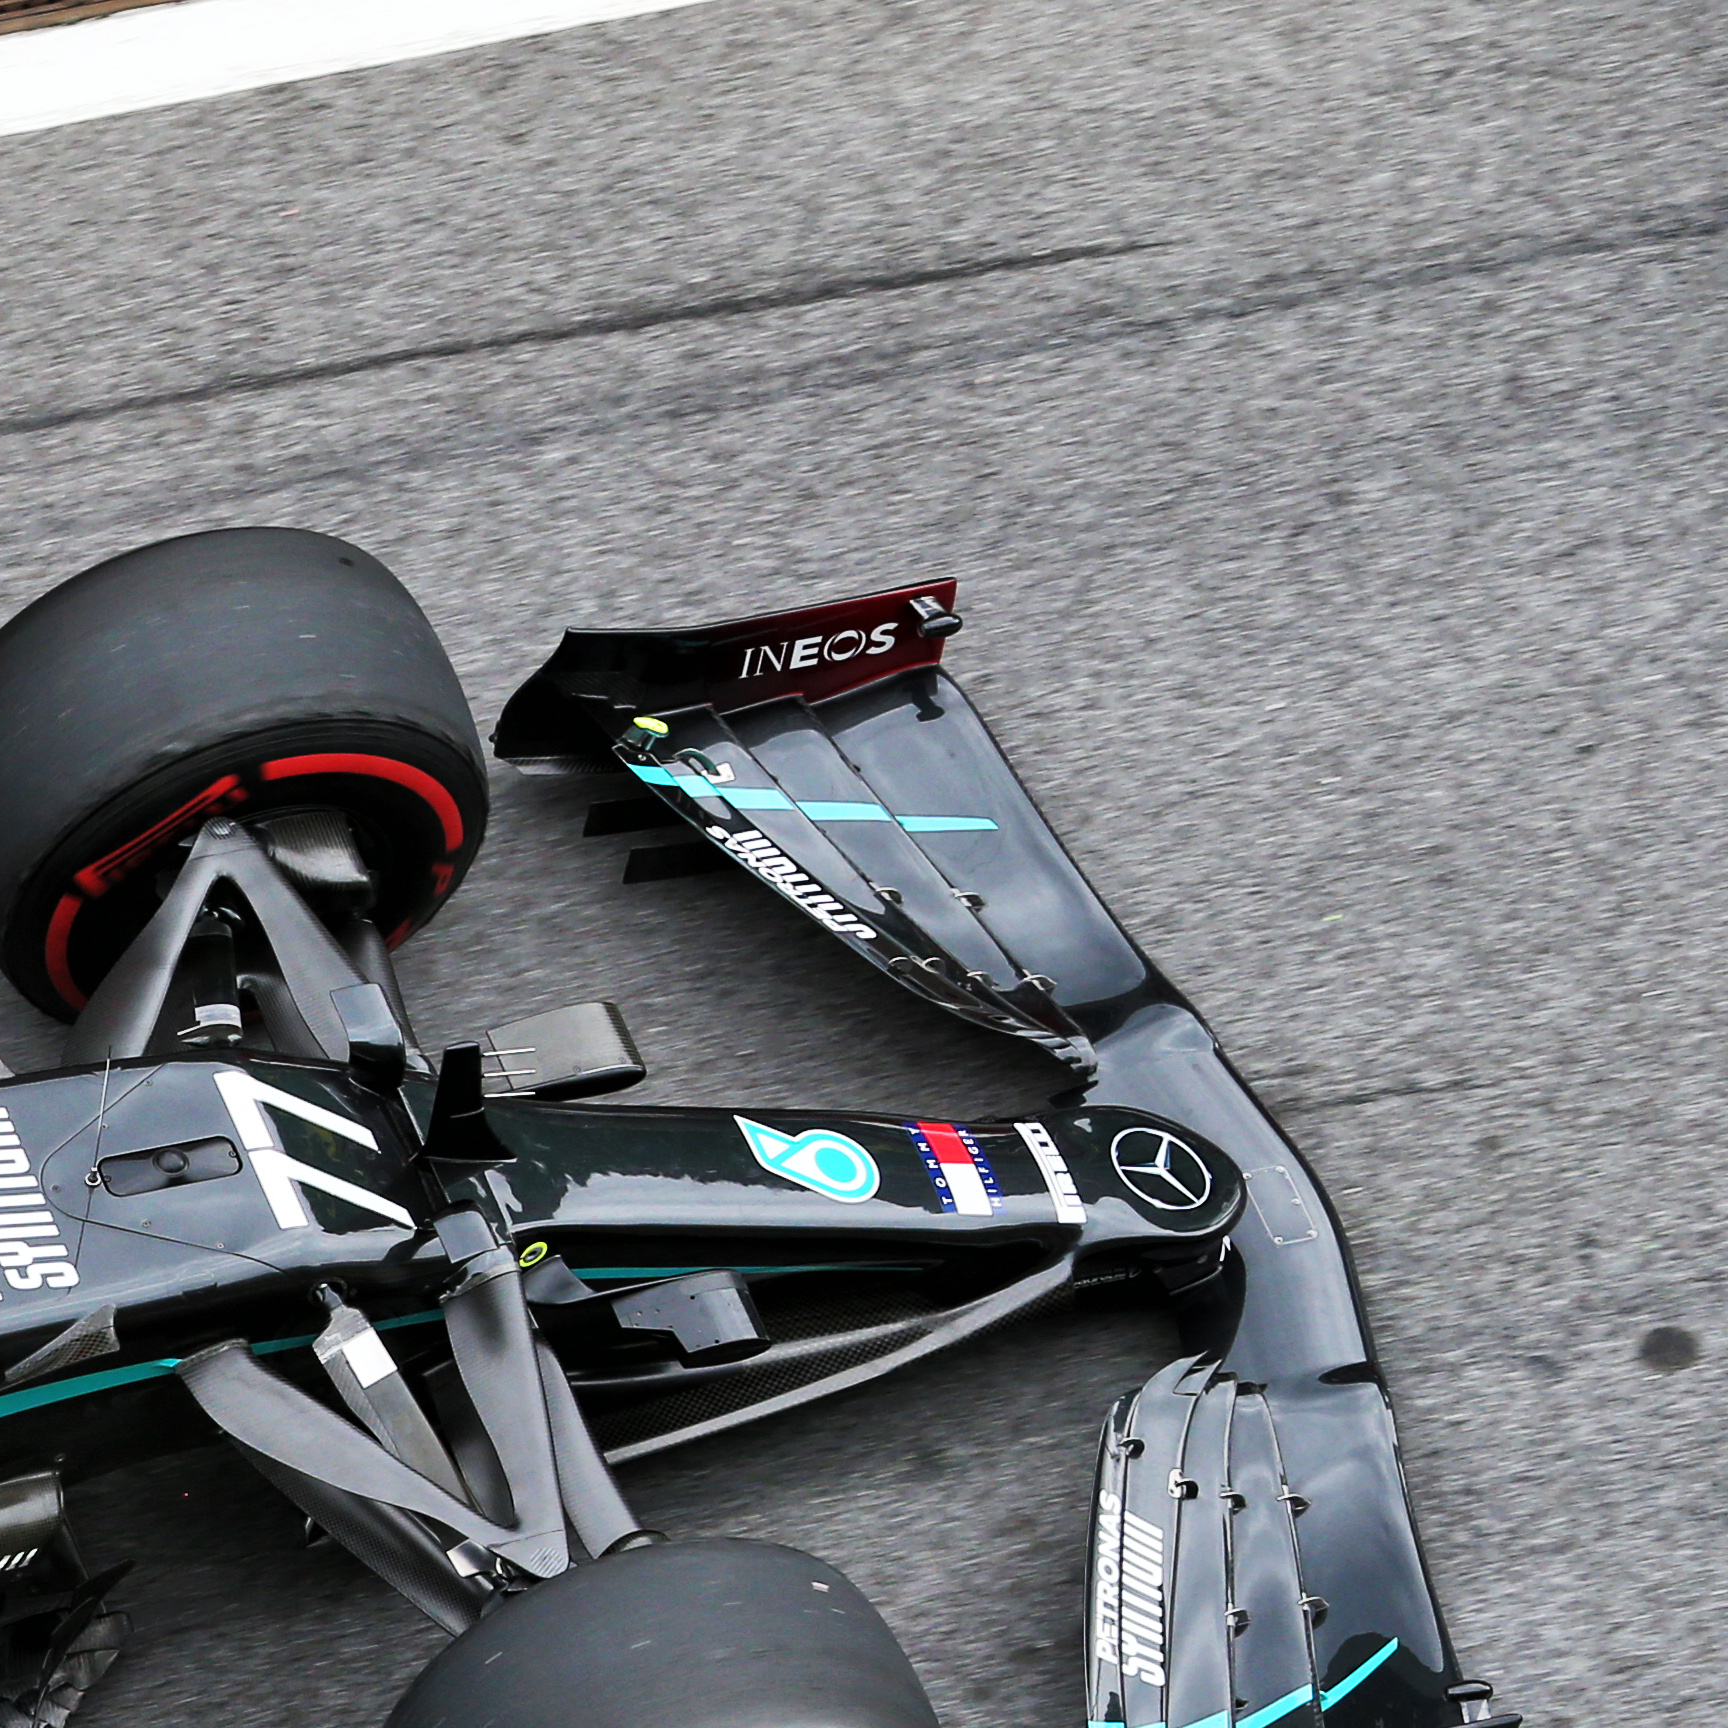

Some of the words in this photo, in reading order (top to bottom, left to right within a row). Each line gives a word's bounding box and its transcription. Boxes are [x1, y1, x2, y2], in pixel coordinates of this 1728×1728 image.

[738, 622, 897, 680] INEOS
[213, 1069, 419, 1231] 77
[908, 1127, 953, 1206] TOMMY
[957, 1129, 1004, 1208] HILFIGER
[1096, 1489, 1122, 1666] PETRONAS
[1121, 1510, 1166, 1687] SYNTIUM
